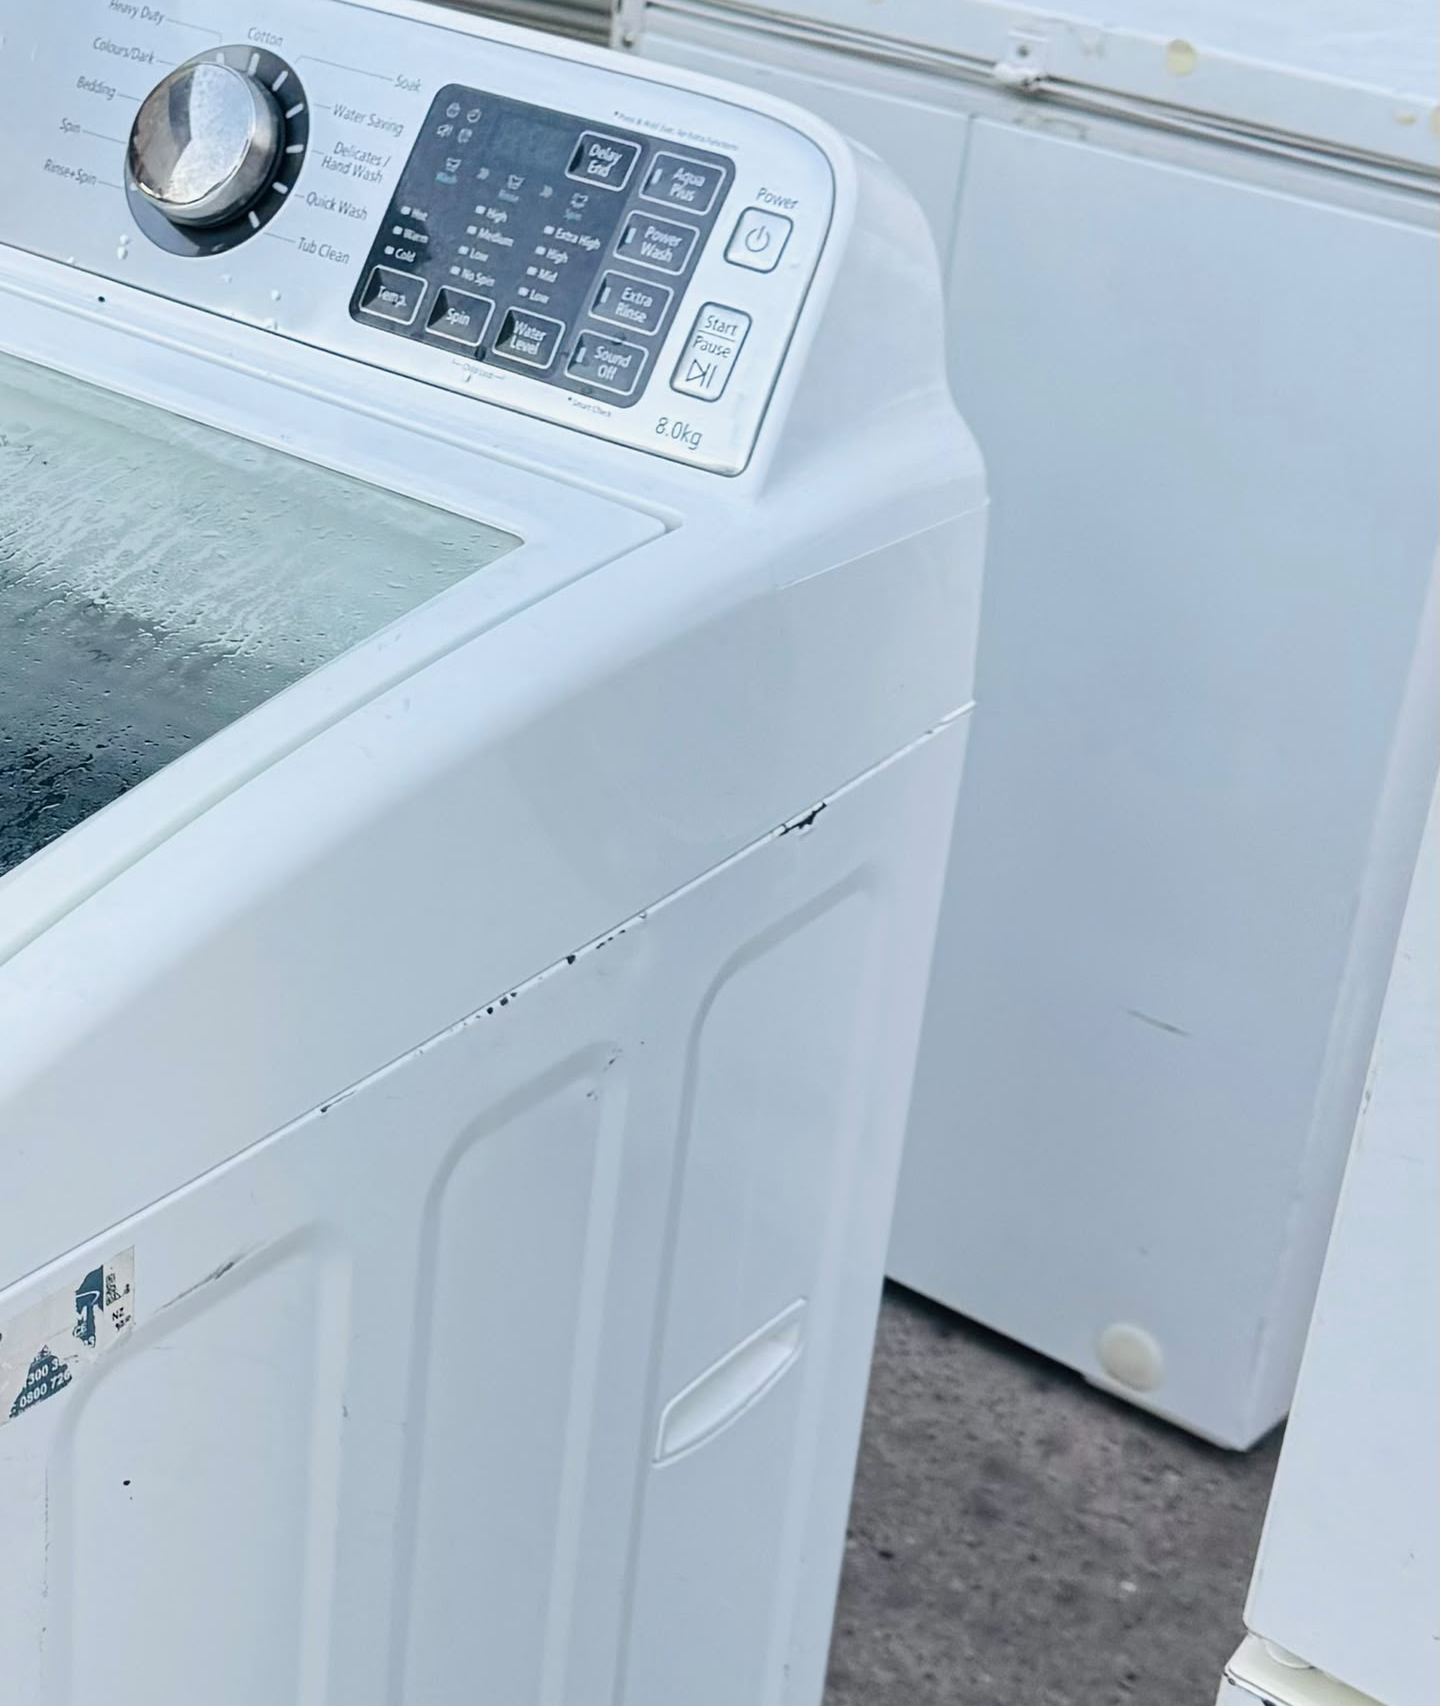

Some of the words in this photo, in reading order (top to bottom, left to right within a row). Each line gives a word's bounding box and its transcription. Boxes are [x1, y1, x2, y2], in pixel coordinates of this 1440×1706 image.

[140, 5, 165, 26] Duty
[247, 27, 284, 47] Cotton
[93, 36, 156, 65] Colours/Dark
[76, 75, 117, 101] Bedding
[394, 74, 422, 93] Soak
[59, 117, 82, 135] Spin
[332, 103, 366, 125] Water
[367, 113, 405, 138] Saving
[333, 141, 382, 167] Delicates
[588, 143, 623, 167] Delay
[321, 155, 350, 175] Hand
[352, 164, 384, 185] Wash
[586, 159, 611, 178] End
[306, 191, 336, 211] Quick
[338, 201, 368, 221] Wash
[755, 186, 800, 210] Power
[644, 225, 683, 248] Power
[297, 236, 317, 255] Tub
[318, 243, 351, 265] Clean
[546, 247, 569, 265] High
[640, 241, 674, 264] Wash
[529, 288, 550, 305] Low
[621, 286, 654, 308] Extra
[445, 307, 471, 326] Spin
[615, 302, 648, 324] Rinse
[513, 320, 548, 342] Water
[704, 314, 739, 337] Start
[509, 335, 542, 356] Level
[593, 345, 633, 369] Sound
[692, 335, 733, 359] Pause
[596, 364, 619, 382] Off
[655, 416, 703, 450] 8.0kg
[20, 1382, 48, 1408] 0800
